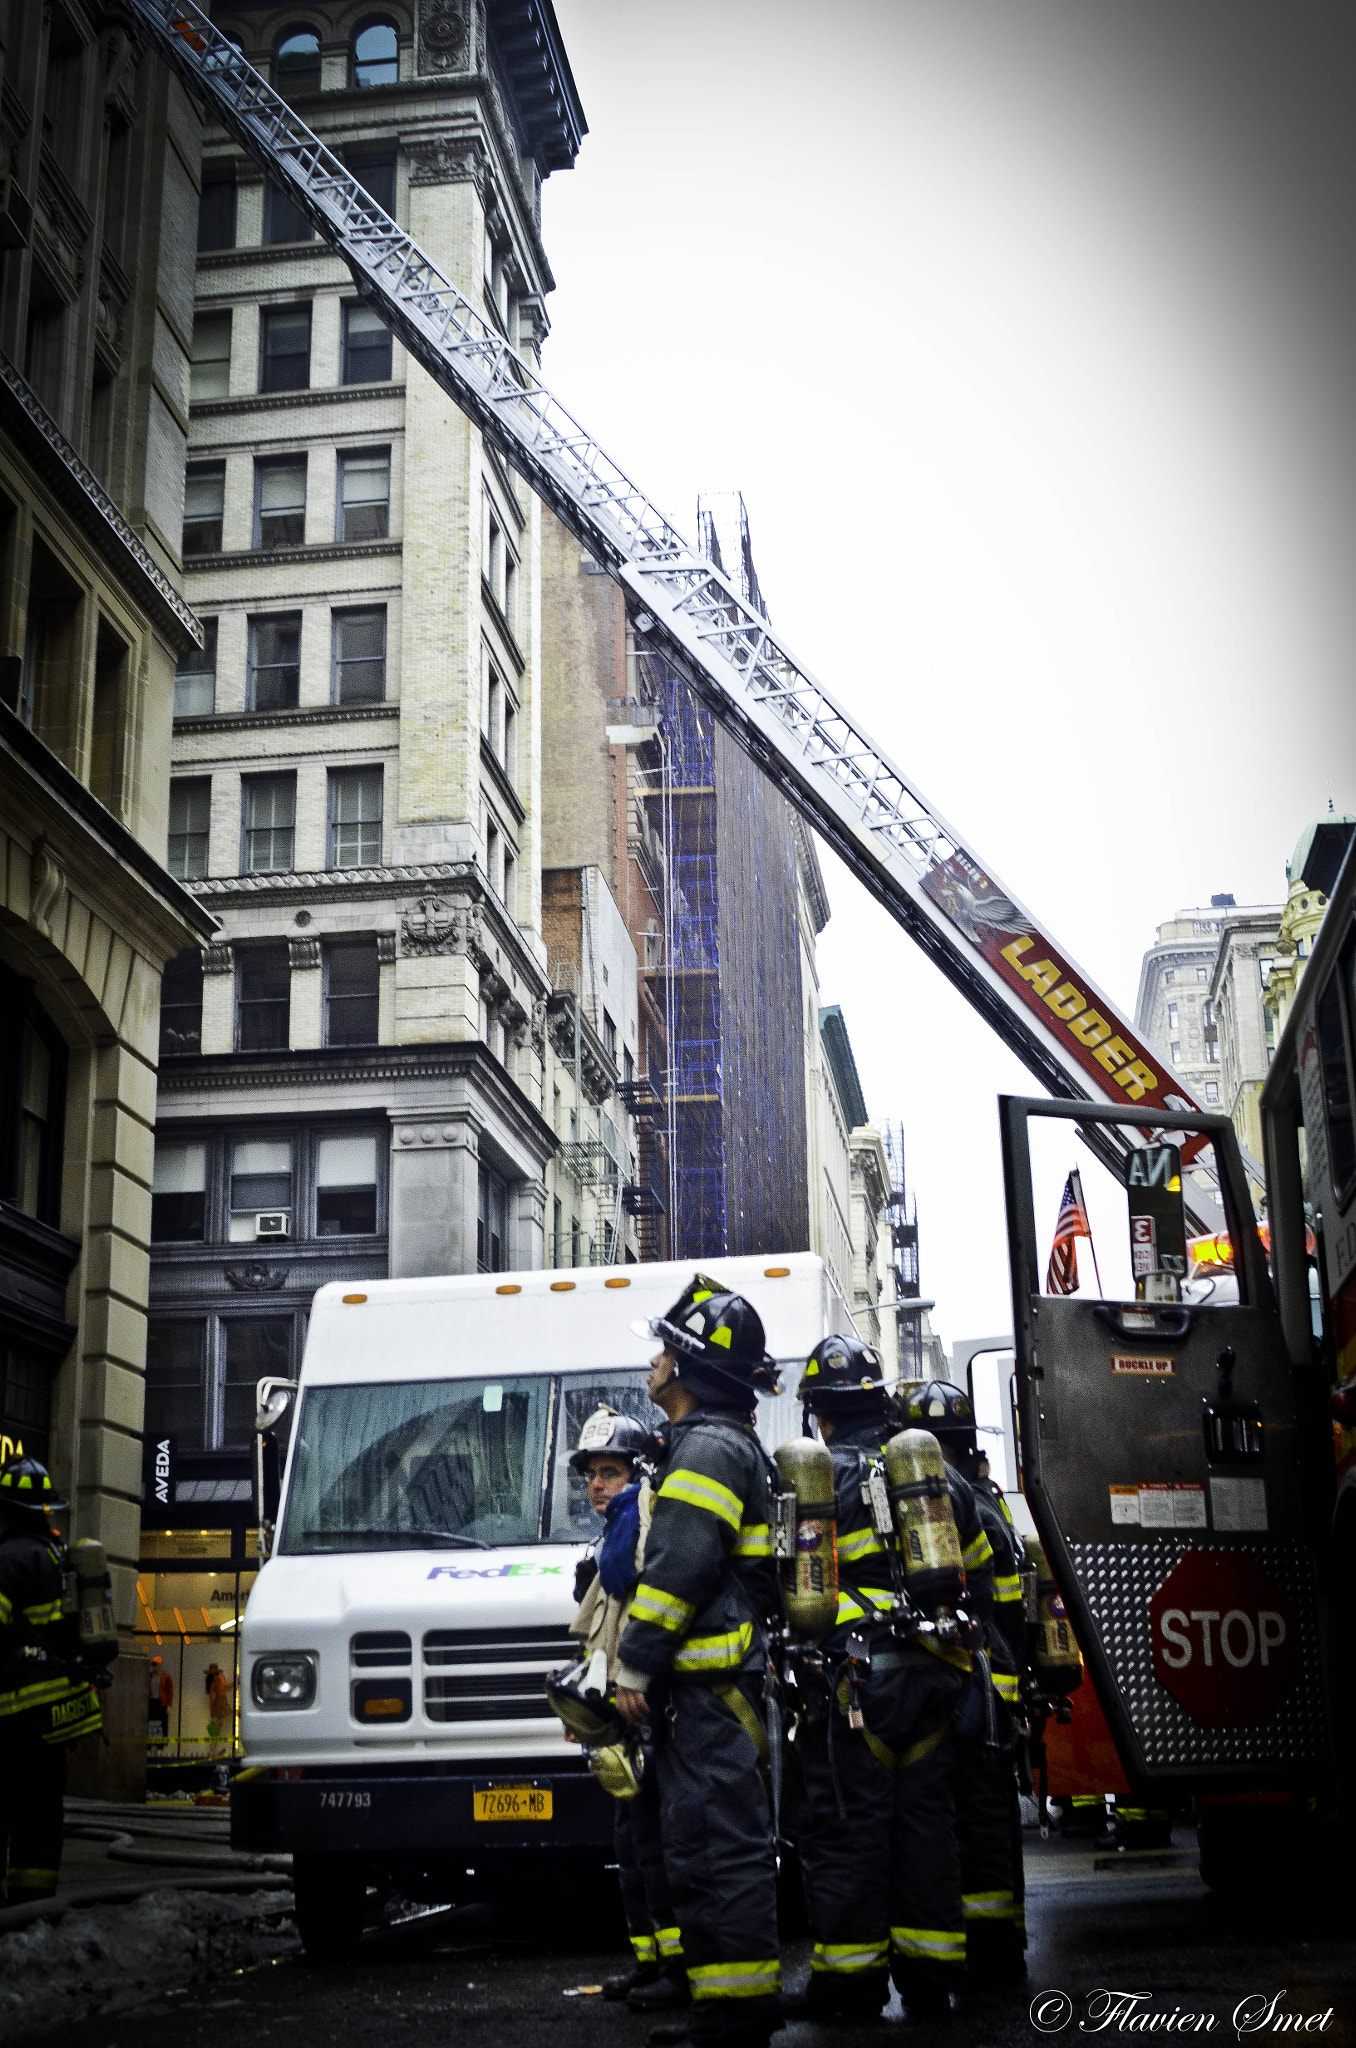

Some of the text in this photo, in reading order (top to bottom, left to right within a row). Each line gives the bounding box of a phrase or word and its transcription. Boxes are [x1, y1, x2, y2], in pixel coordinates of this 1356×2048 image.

[999, 935, 1158, 1101] LADDER
[1118, 1358, 1169, 1371] BUCKLE UP
[0, 1433, 24, 1466] DA
[155, 1439, 170, 1504] AVEDA
[426, 1562, 565, 1580] FedEx
[1160, 1608, 1287, 1669] STOP
[319, 1792, 371, 1808] 747793
